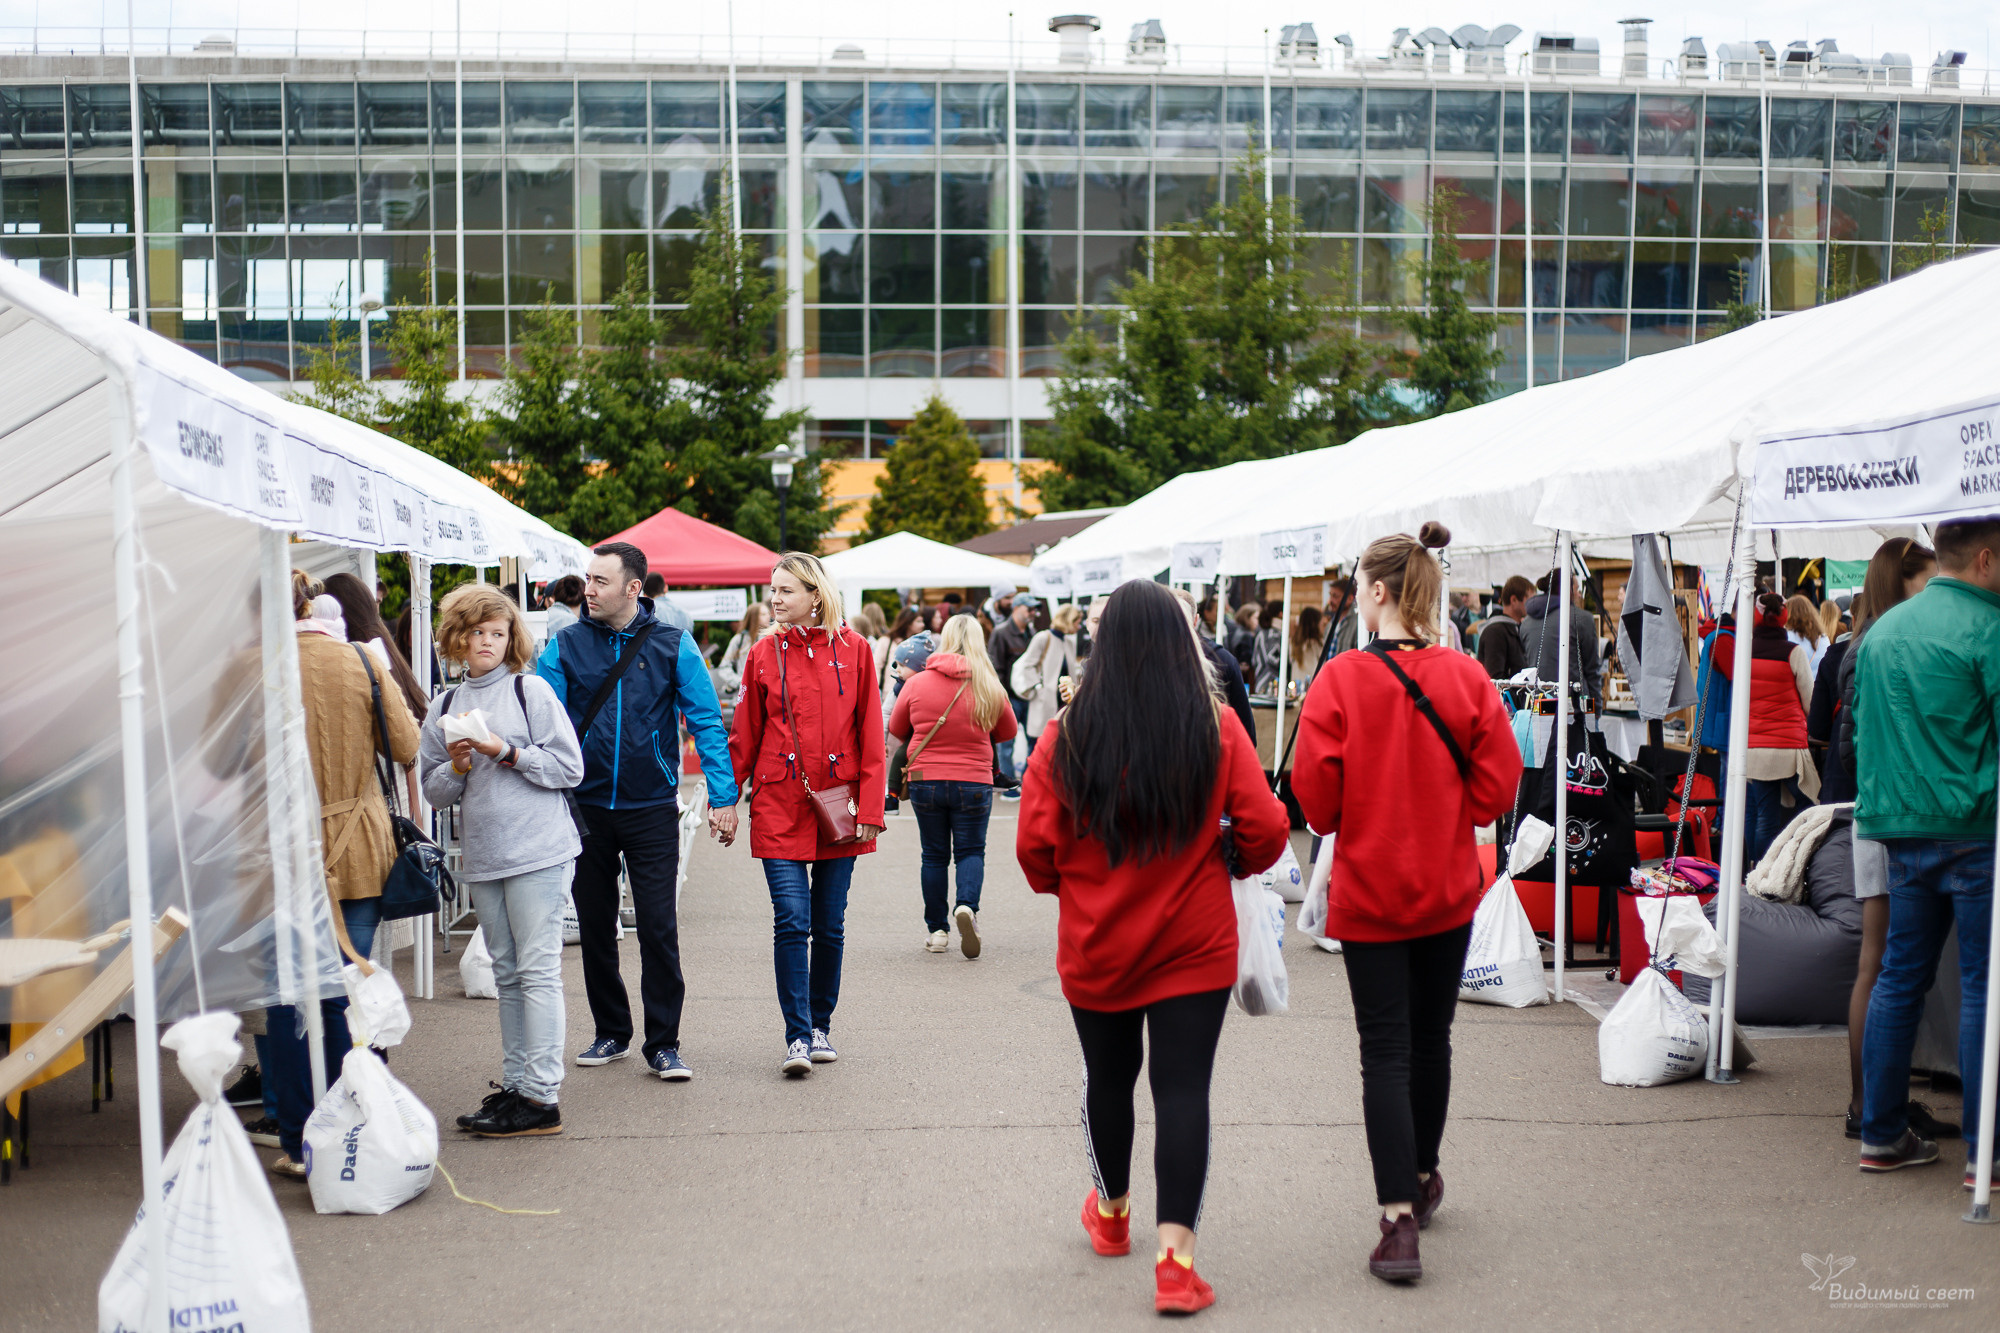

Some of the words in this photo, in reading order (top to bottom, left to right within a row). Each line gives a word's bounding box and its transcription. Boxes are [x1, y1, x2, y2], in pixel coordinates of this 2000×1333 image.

[1960, 420, 1994, 446] OPEN
[1963, 443, 2000, 471] SPACE
[1783, 455, 1921, 501] ДЕРЕВО&СНЕКИ
